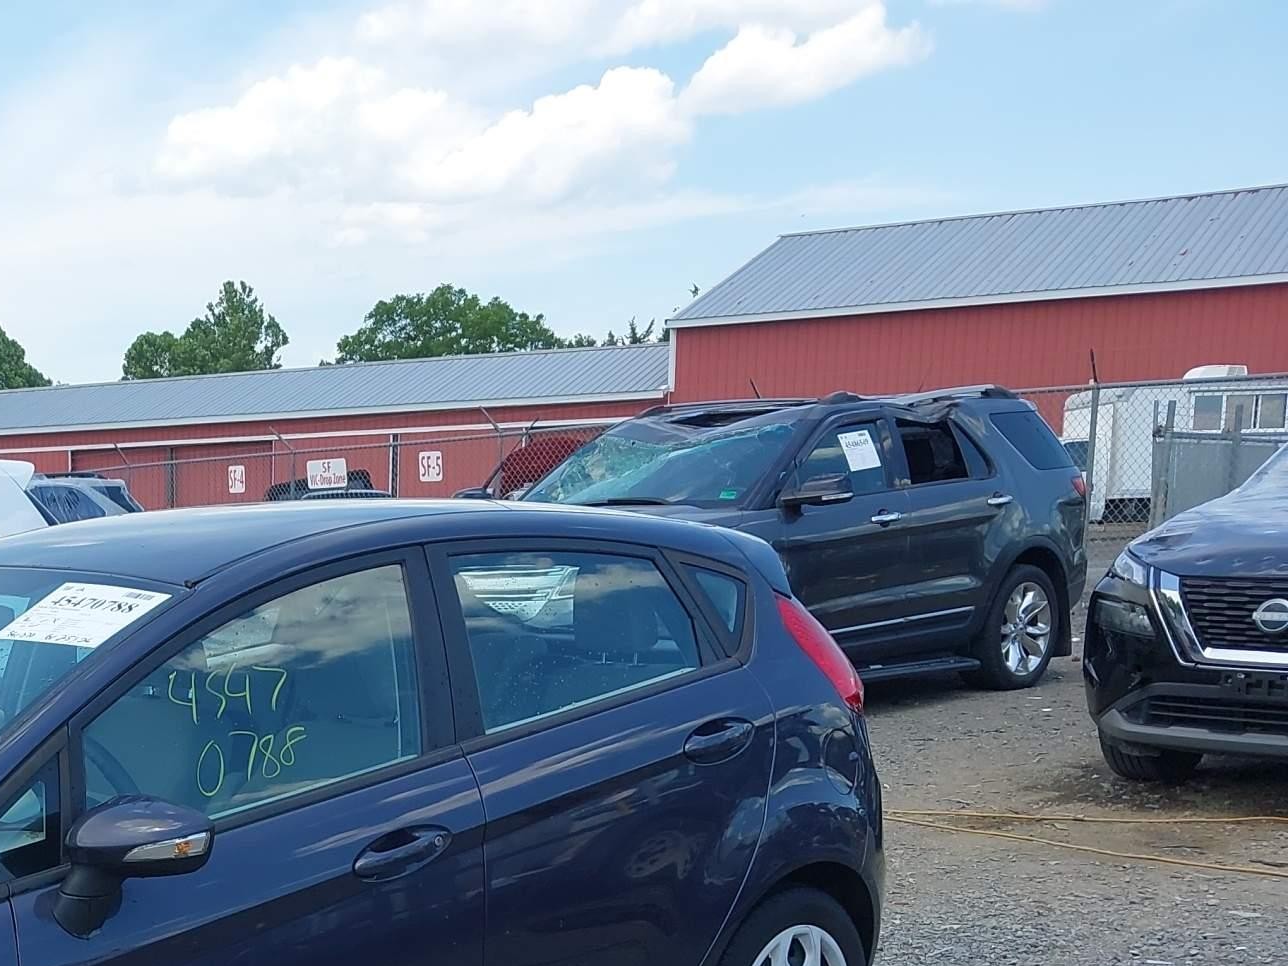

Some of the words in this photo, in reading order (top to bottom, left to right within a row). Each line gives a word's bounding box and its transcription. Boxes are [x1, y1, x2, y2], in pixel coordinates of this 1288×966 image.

[322, 461, 332, 474] SF
[421, 455, 441, 477] SF-5
[229, 469, 244, 489] SF-4
[51, 595, 140, 614] 45470788
[168, 662, 288, 725] 4547
[197, 726, 308, 797] 0788
